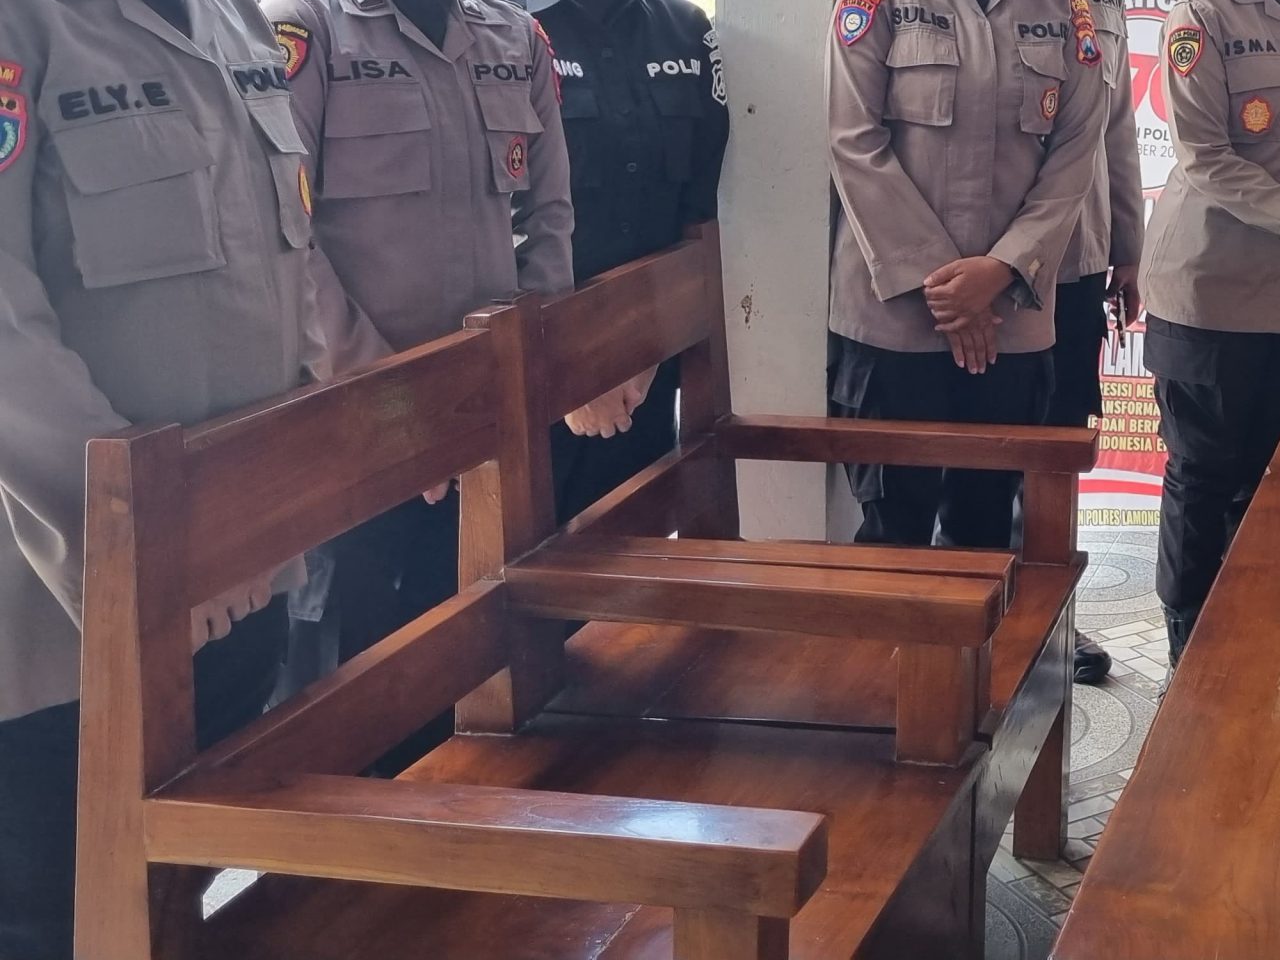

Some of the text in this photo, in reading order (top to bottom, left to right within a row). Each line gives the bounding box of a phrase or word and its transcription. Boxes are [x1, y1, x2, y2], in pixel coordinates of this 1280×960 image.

[892, 7, 950, 29] SULIS
[1225, 39, 1277, 56] ISMA
[328, 60, 412, 82] LISA
[473, 63, 533, 82] POLR
[58, 82, 170, 121] ELY.E
[1144, 127, 1169, 141] POL
[1137, 144, 1175, 158] BER 20
[1136, 383, 1155, 399] ME
[1102, 399, 1161, 416] NSFORMA
[1101, 417, 1126, 433] DAN
[1129, 419, 1160, 434] BERK
[1099, 435, 1152, 451] DONESIA
[1085, 509, 1120, 526] POLRES
[1121, 509, 1160, 526] LAMONG
